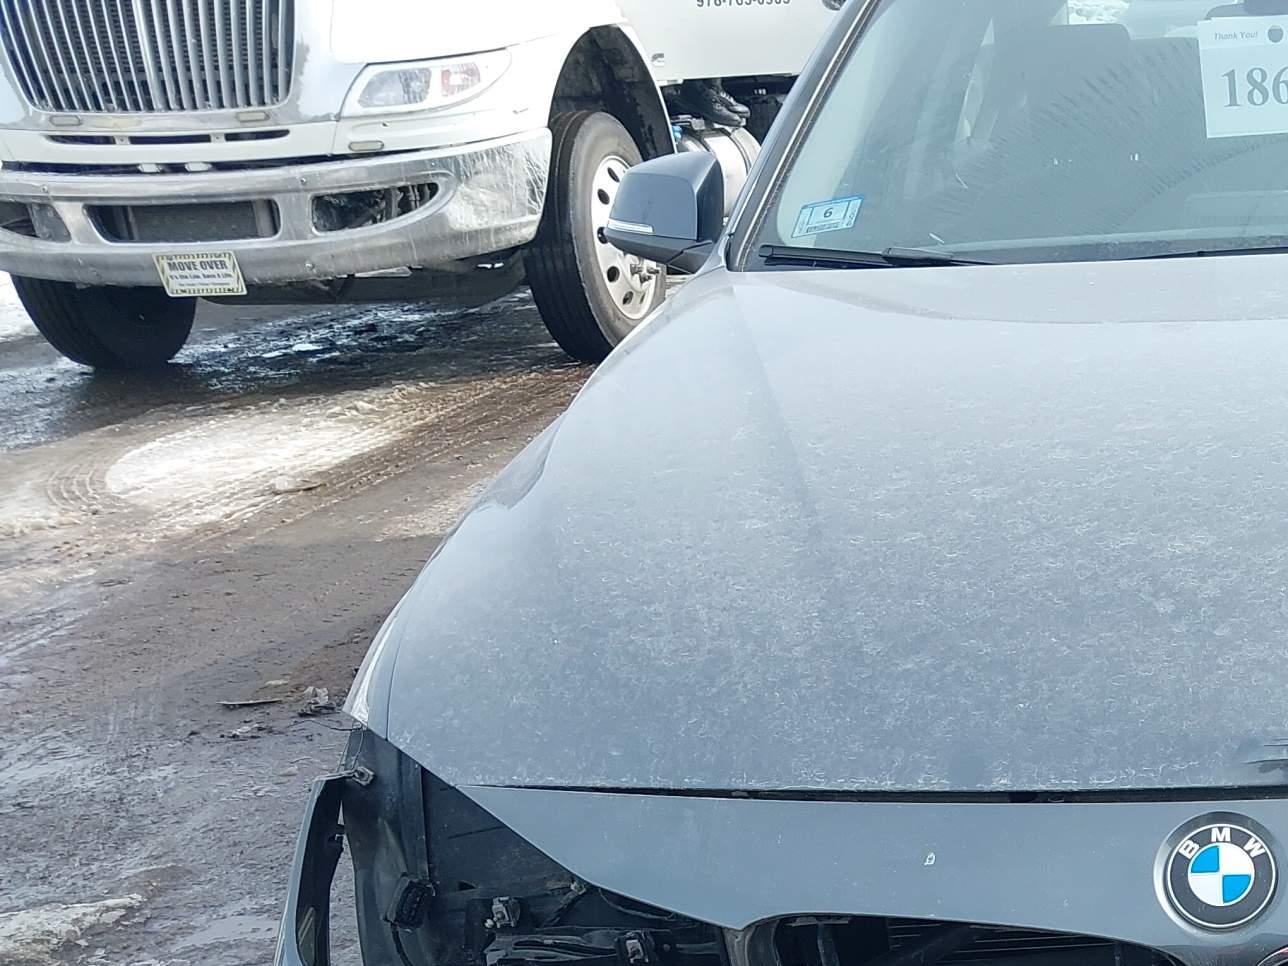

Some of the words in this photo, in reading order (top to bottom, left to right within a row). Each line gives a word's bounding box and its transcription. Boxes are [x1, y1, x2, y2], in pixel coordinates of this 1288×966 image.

[1213, 31, 1238, 41] Thank
[1239, 31, 1258, 39] You!
[823, 207, 834, 218] 6
[167, 261, 198, 271] MOVE
[200, 260, 228, 270] OVER
[1178, 827, 1266, 860] BMW
